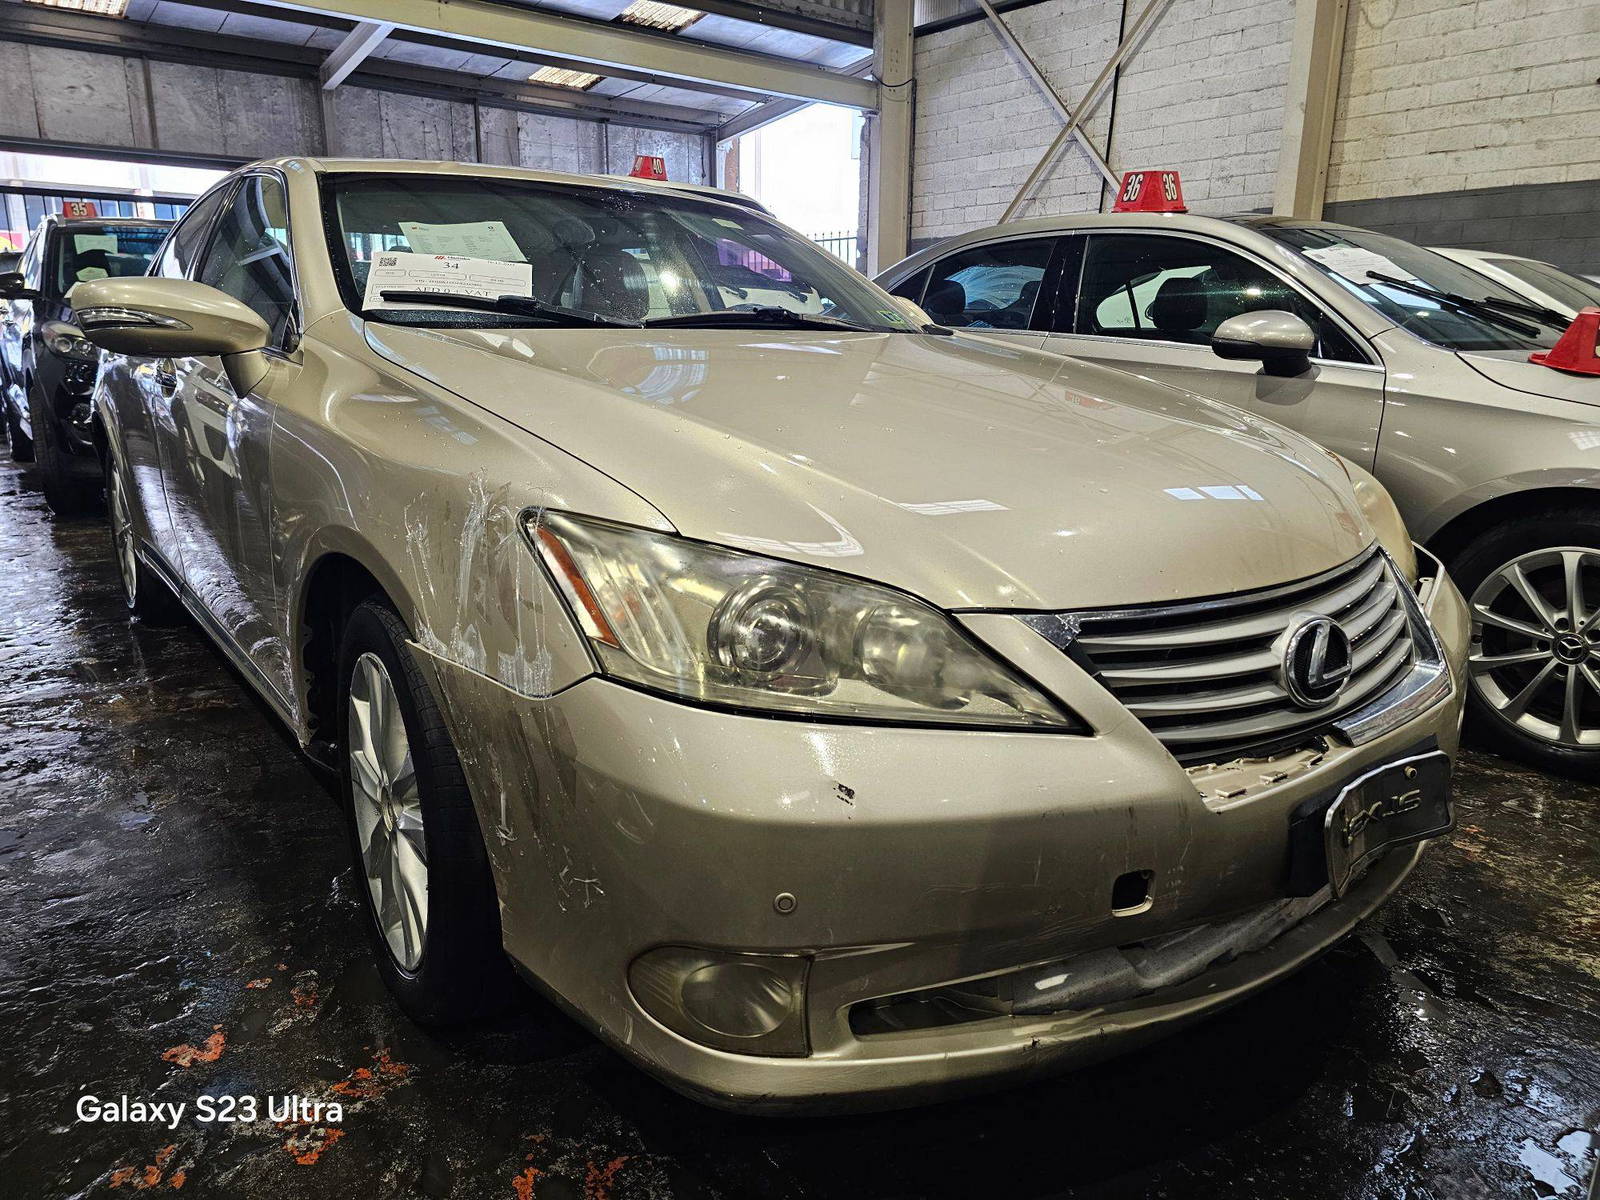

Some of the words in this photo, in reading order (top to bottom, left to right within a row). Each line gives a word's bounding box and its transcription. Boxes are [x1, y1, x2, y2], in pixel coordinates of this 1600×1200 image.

[1122, 173, 1144, 202] 36
[1162, 173, 1178, 201] 36
[70, 202, 88, 216] 35
[465, 289, 491, 297] VAT
